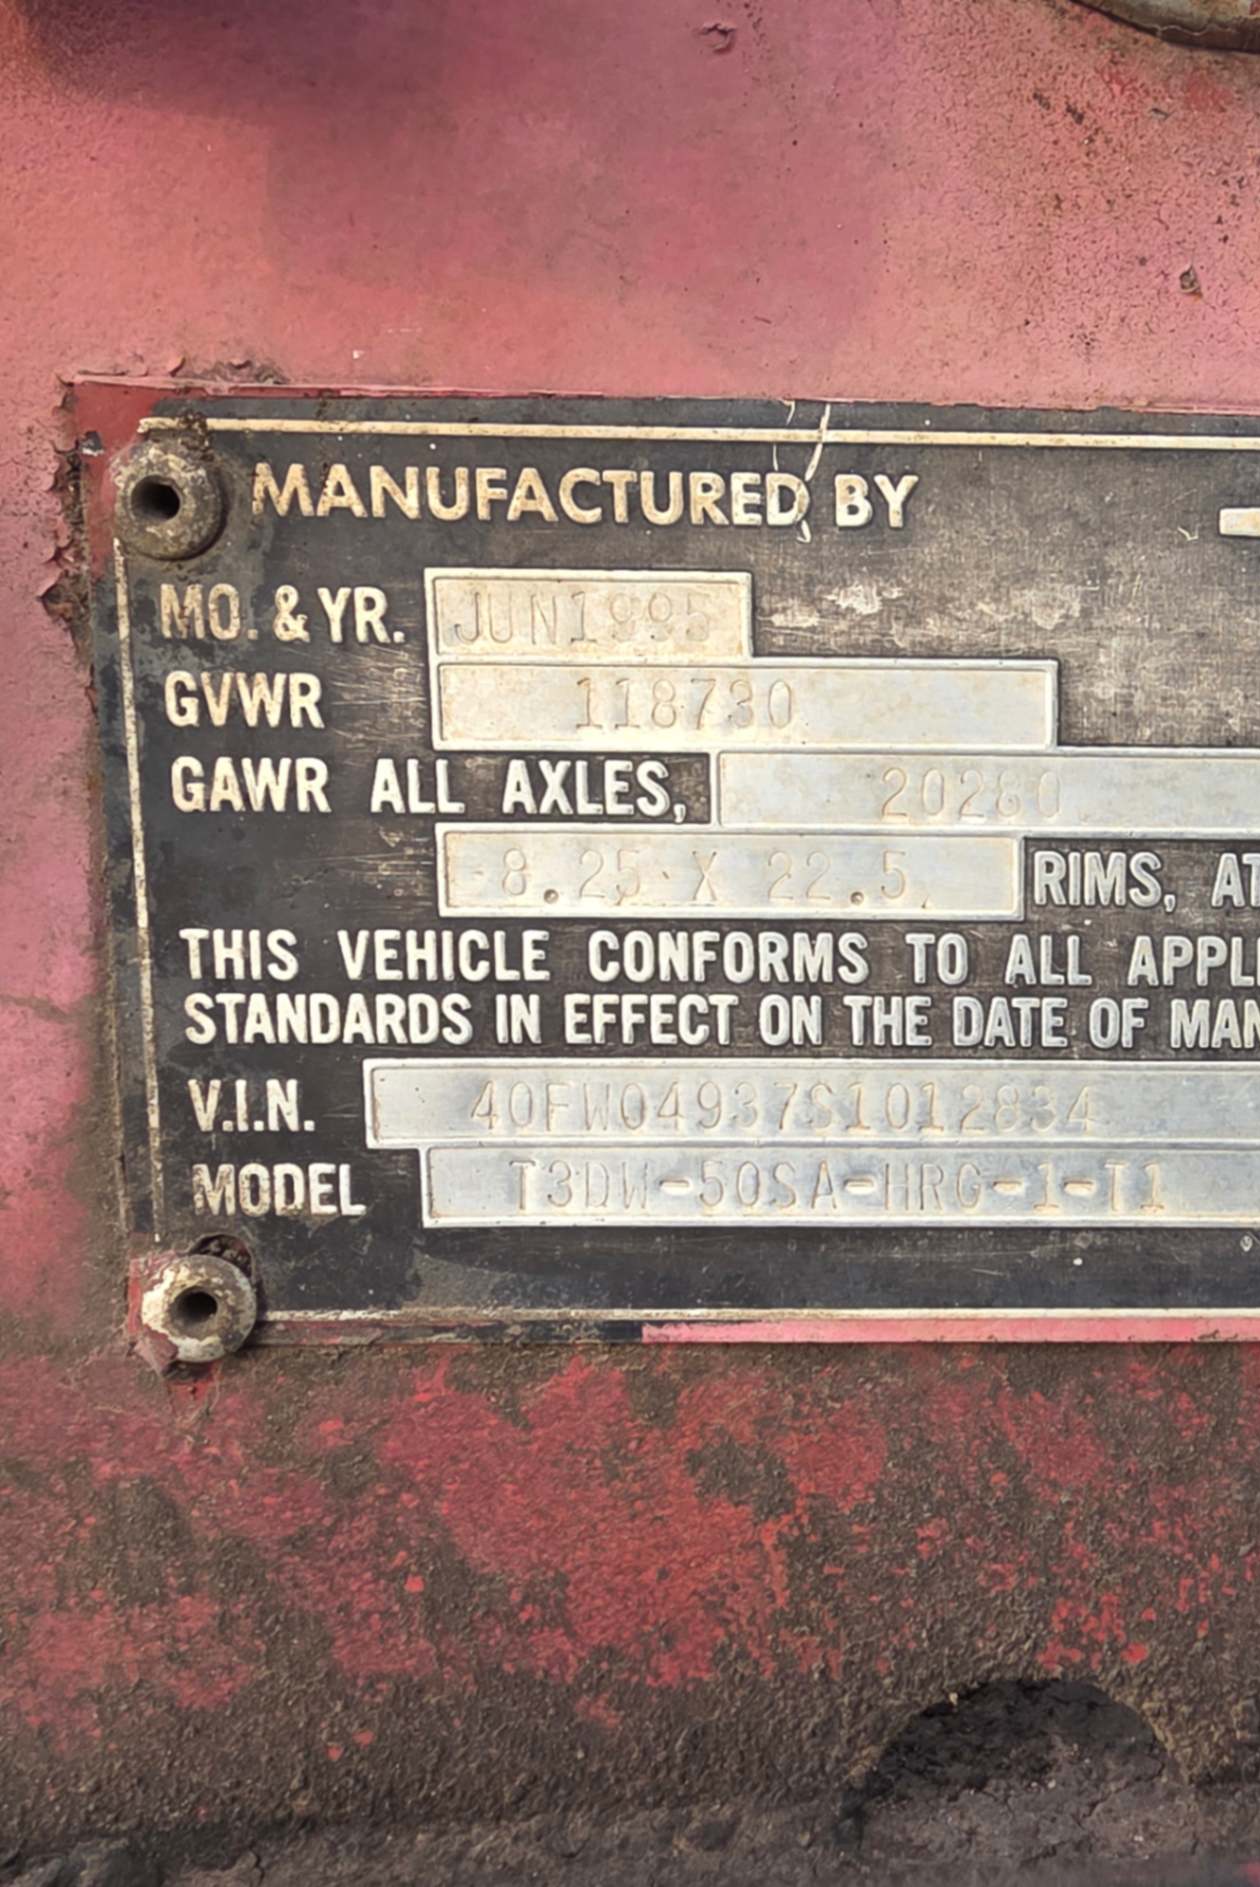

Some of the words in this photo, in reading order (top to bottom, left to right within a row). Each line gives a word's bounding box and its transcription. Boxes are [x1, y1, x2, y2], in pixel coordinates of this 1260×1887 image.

[252, 463, 808, 526] MANUFACTURED
[835, 474, 918, 529] BY
[160, 584, 257, 641] MO.
[274, 584, 310, 642] &
[319, 585, 405, 644] YR.
[164, 671, 325, 729] GVWR
[574, 675, 793, 731] 118730
[171, 756, 331, 813] GAWR
[370, 758, 465, 814] ALL
[502, 759, 687, 824] AXLES,
[691, 849, 718, 902] X
[1034, 850, 1176, 913] RIMS,
[179, 928, 299, 981] THIS
[337, 929, 551, 982] VEHICLE
[588, 930, 870, 984] CONFORMS
[905, 932, 969, 985] TO
[1004, 933, 1092, 987] ALL
[184, 992, 474, 1045] STANDARDS
[496, 993, 541, 1045] IN
[564, 993, 739, 1046] EFFECT
[758, 994, 823, 1047] ON
[843, 995, 932, 1047] THE
[953, 996, 1068, 1049] DATE
[1088, 997, 1149, 1049] OF
[187, 1078, 316, 1132] V.I.N.
[193, 1162, 367, 1217] MODEL
